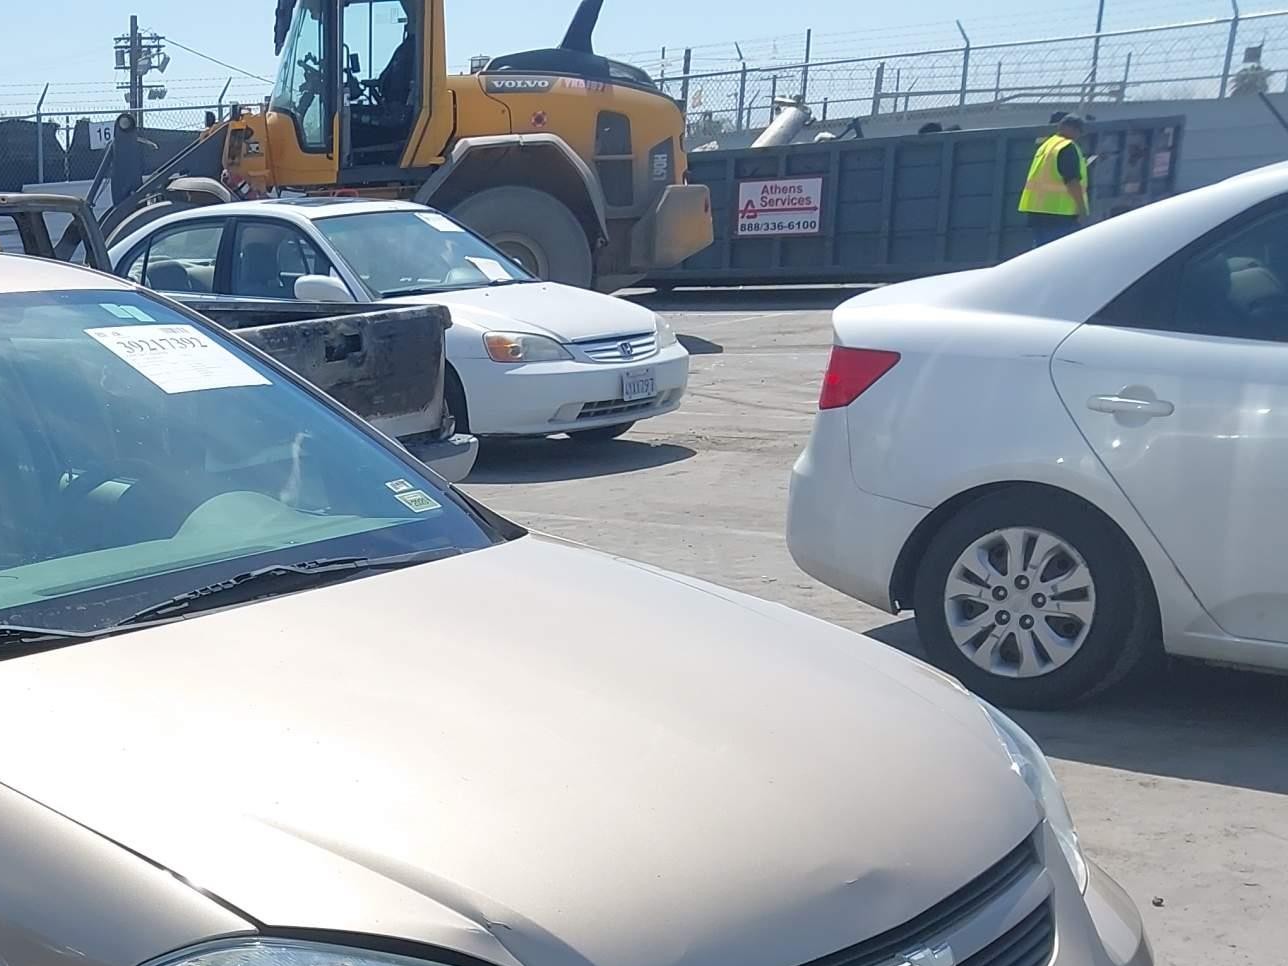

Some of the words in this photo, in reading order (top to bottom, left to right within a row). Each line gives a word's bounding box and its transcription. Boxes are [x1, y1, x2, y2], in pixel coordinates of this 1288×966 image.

[492, 80, 549, 88] VOLVO
[97, 127, 111, 141] 16
[761, 184, 803, 195] Athens
[760, 195, 812, 207] Services
[740, 220, 817, 232] 888/336-6100
[116, 336, 208, 354] 39217392
